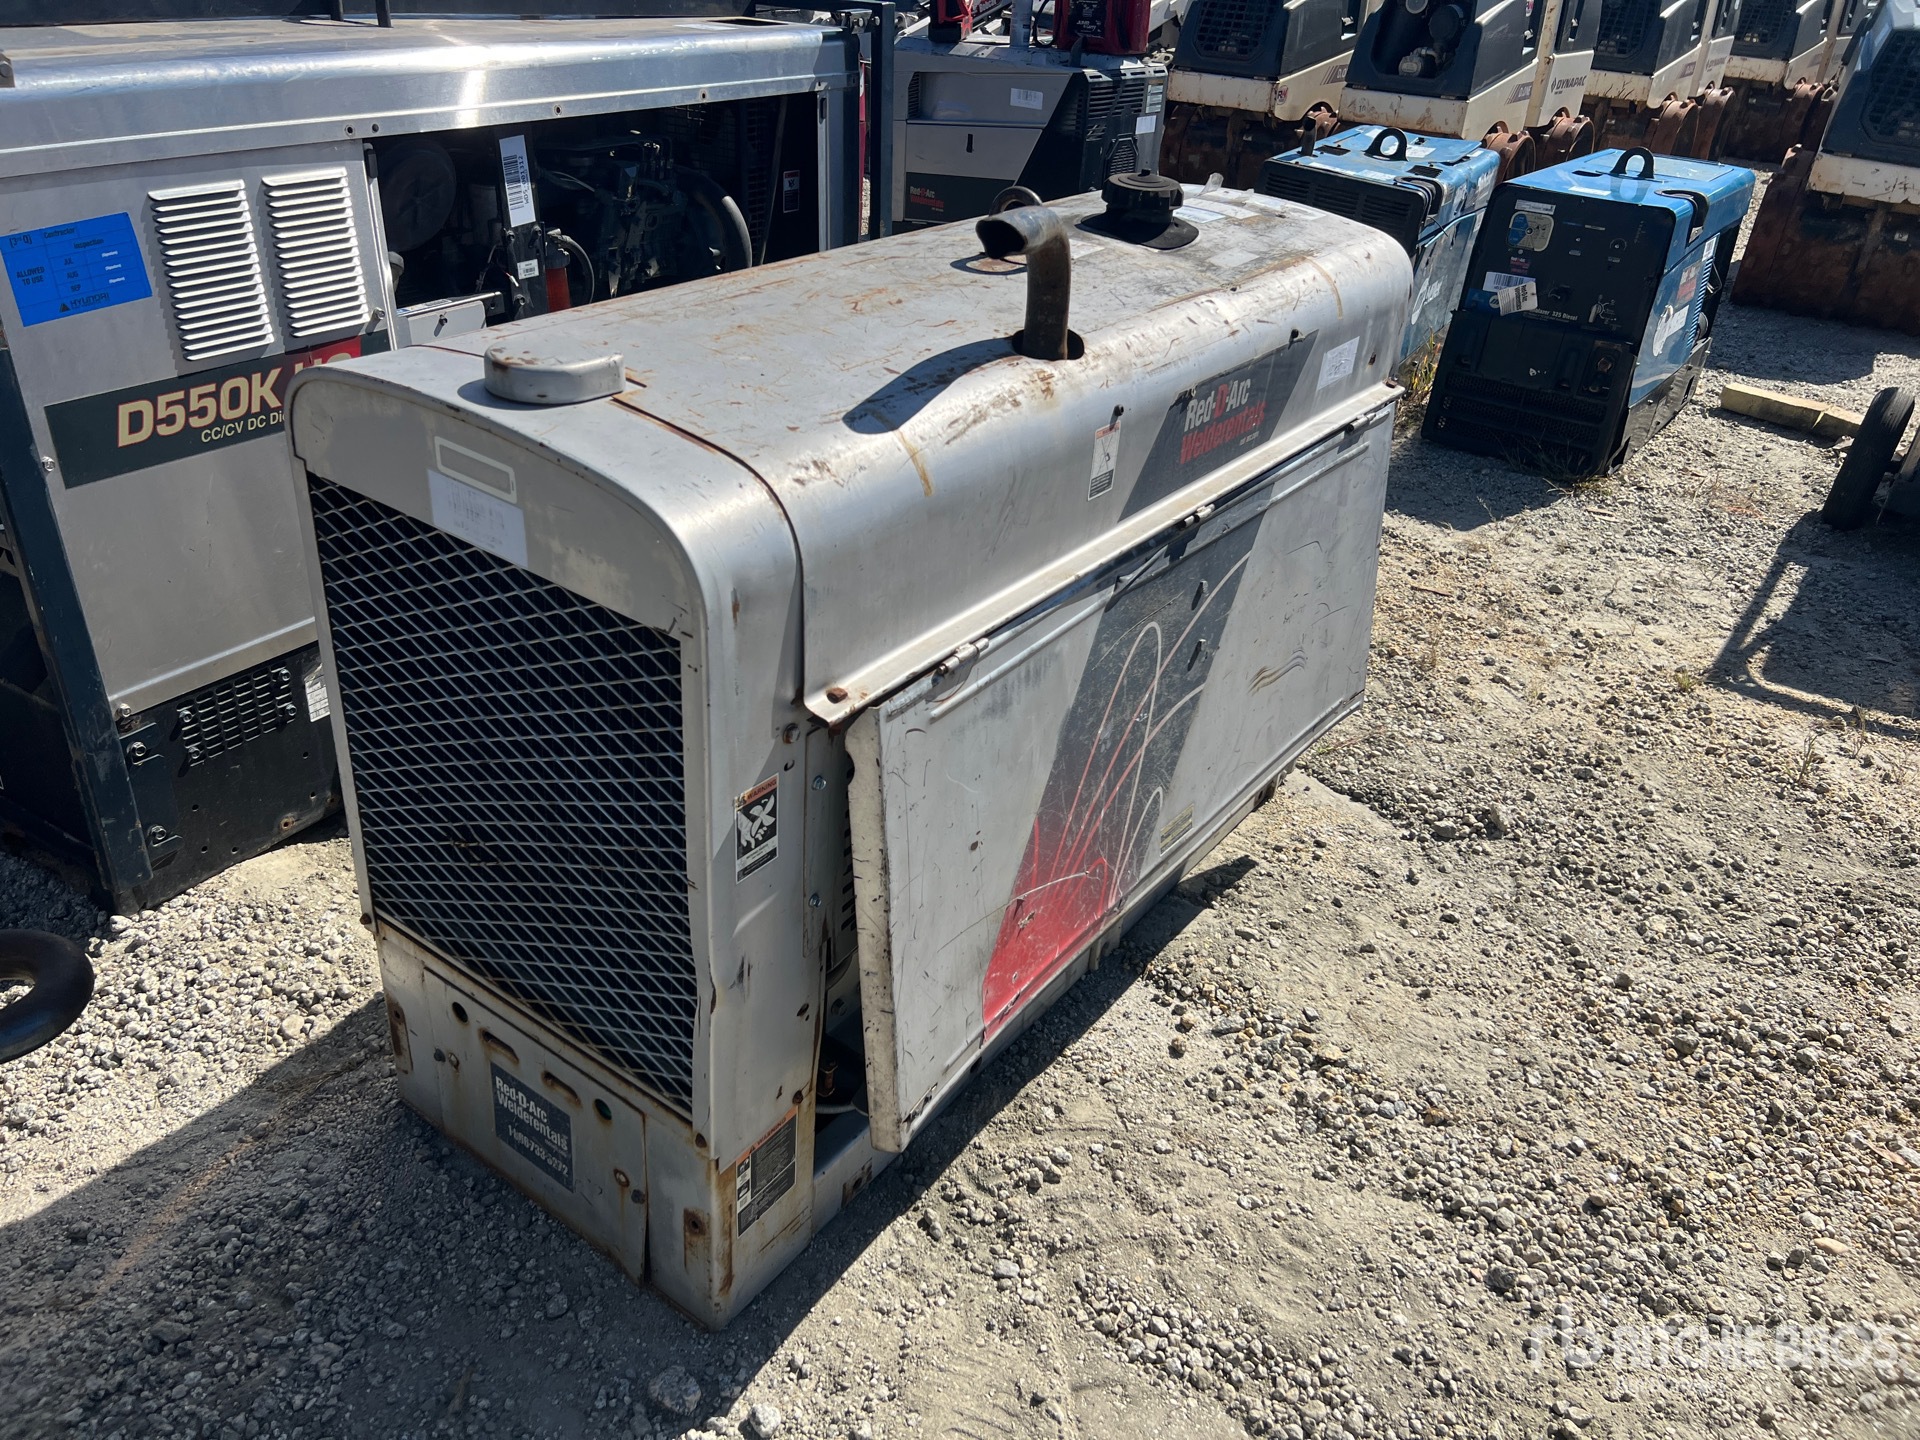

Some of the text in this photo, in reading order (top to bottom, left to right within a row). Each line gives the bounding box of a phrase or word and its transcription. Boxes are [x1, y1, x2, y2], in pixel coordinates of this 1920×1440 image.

[1556, 75, 1587, 90] DYNAPAC
[43, 227, 76, 239] Contractor
[73, 238, 105, 249] Inspection
[16, 266, 45, 278] ALLOWED
[67, 271, 79, 279] AUG
[22, 275, 44, 287] TO USE
[70, 292, 110, 306] HYUNDAI
[1551, 310, 1562, 318] 325
[117, 366, 283, 449] D550K
[1184, 378, 1252, 432] Red-D-Arc
[201, 419, 246, 443] CC/CV
[247, 413, 267, 431] DC
[1180, 399, 1268, 465] Welderentals
[747, 778, 777, 799] WARNING
[495, 1075, 548, 1123] Red-D-Arc
[497, 1090, 569, 1151] Welderentals
